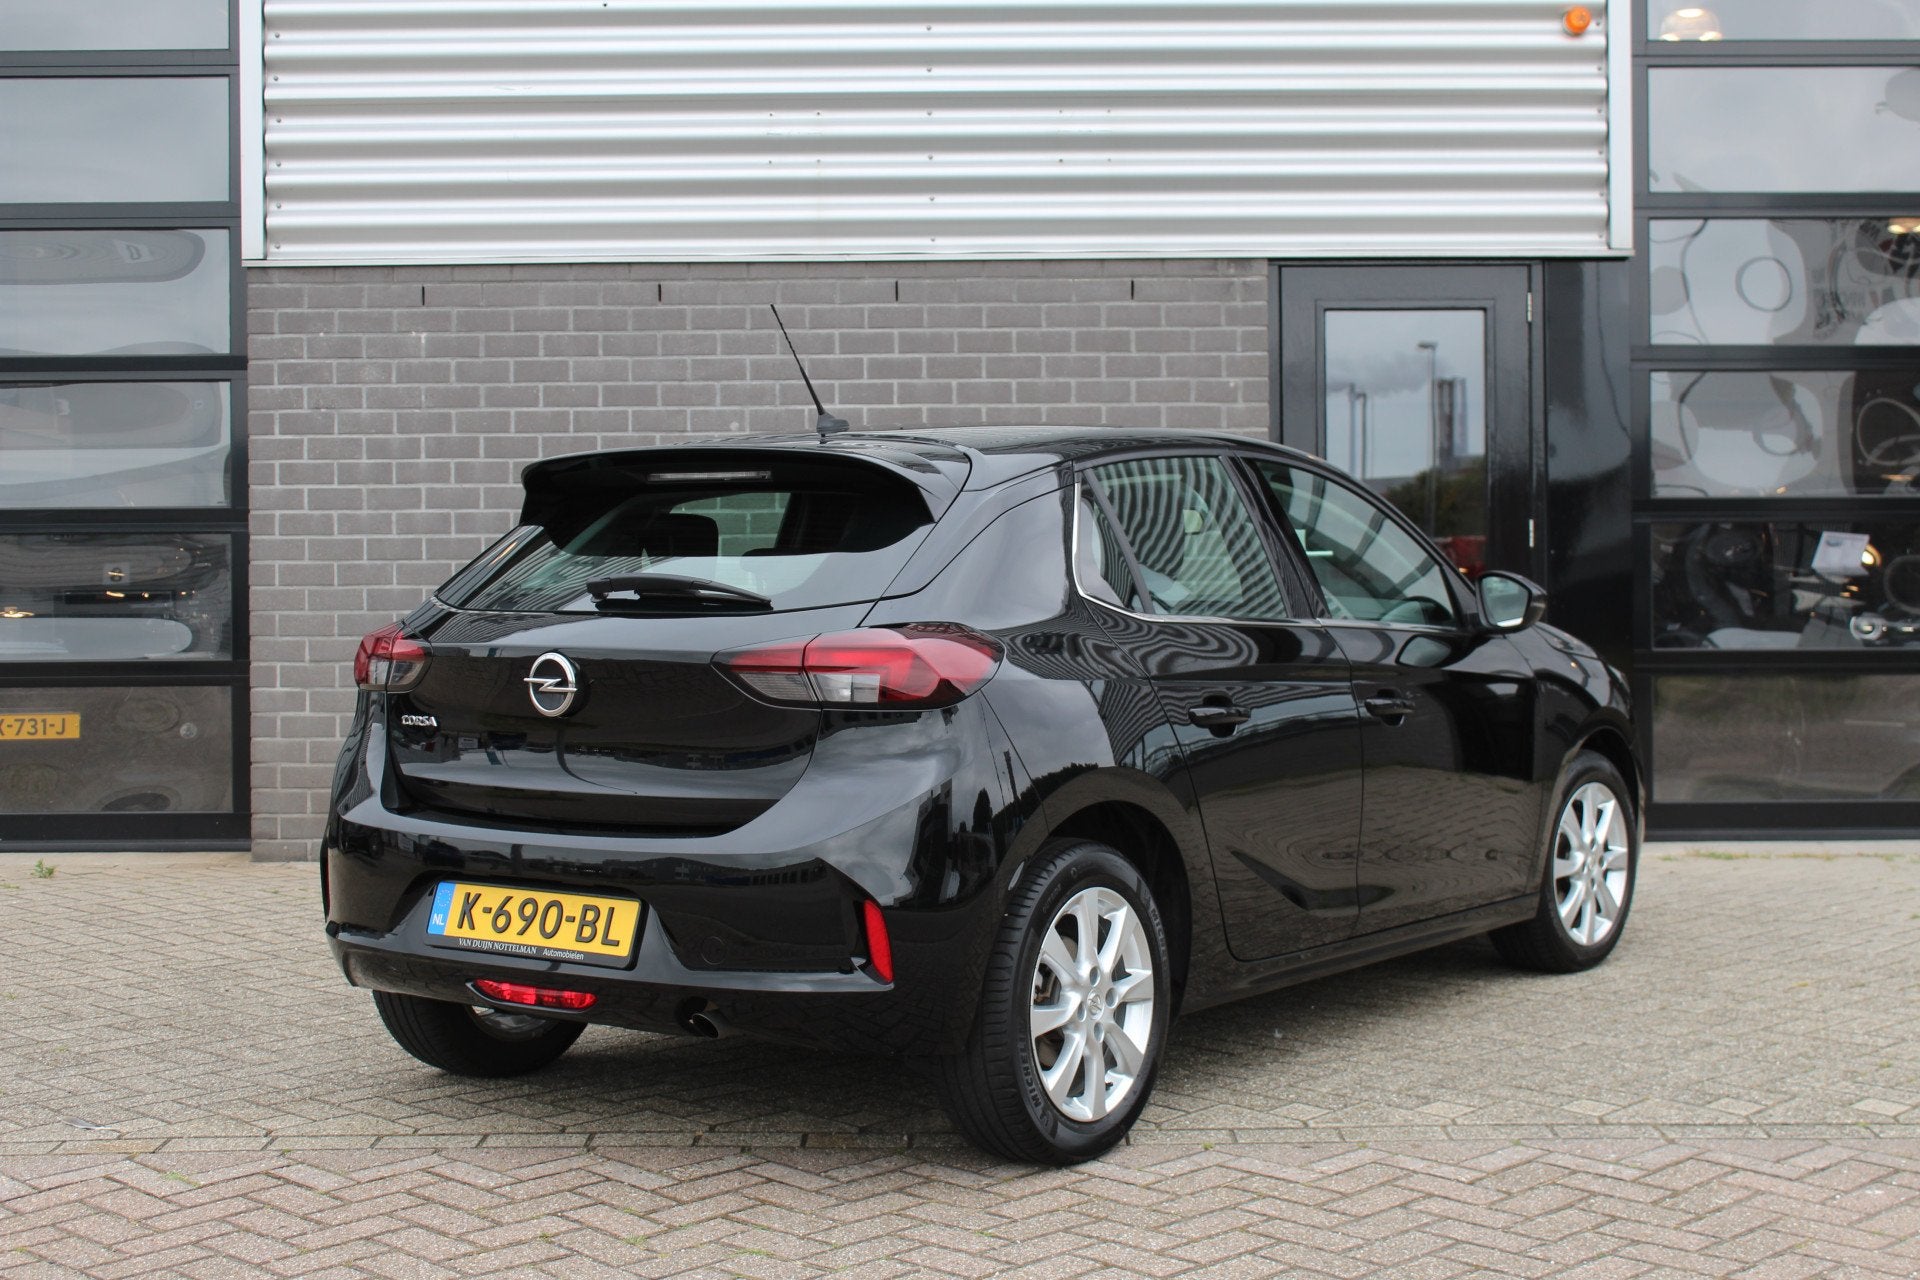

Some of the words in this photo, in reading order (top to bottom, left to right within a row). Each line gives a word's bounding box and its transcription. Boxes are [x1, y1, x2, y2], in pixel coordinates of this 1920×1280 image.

[401, 714, 438, 727] CORSA
[432, 913, 445, 926] NL
[457, 891, 620, 947] K-690-BL
[459, 938, 472, 947] VAN
[493, 942, 538, 955] NOTTELMAN
[542, 948, 584, 960] Automobielen
